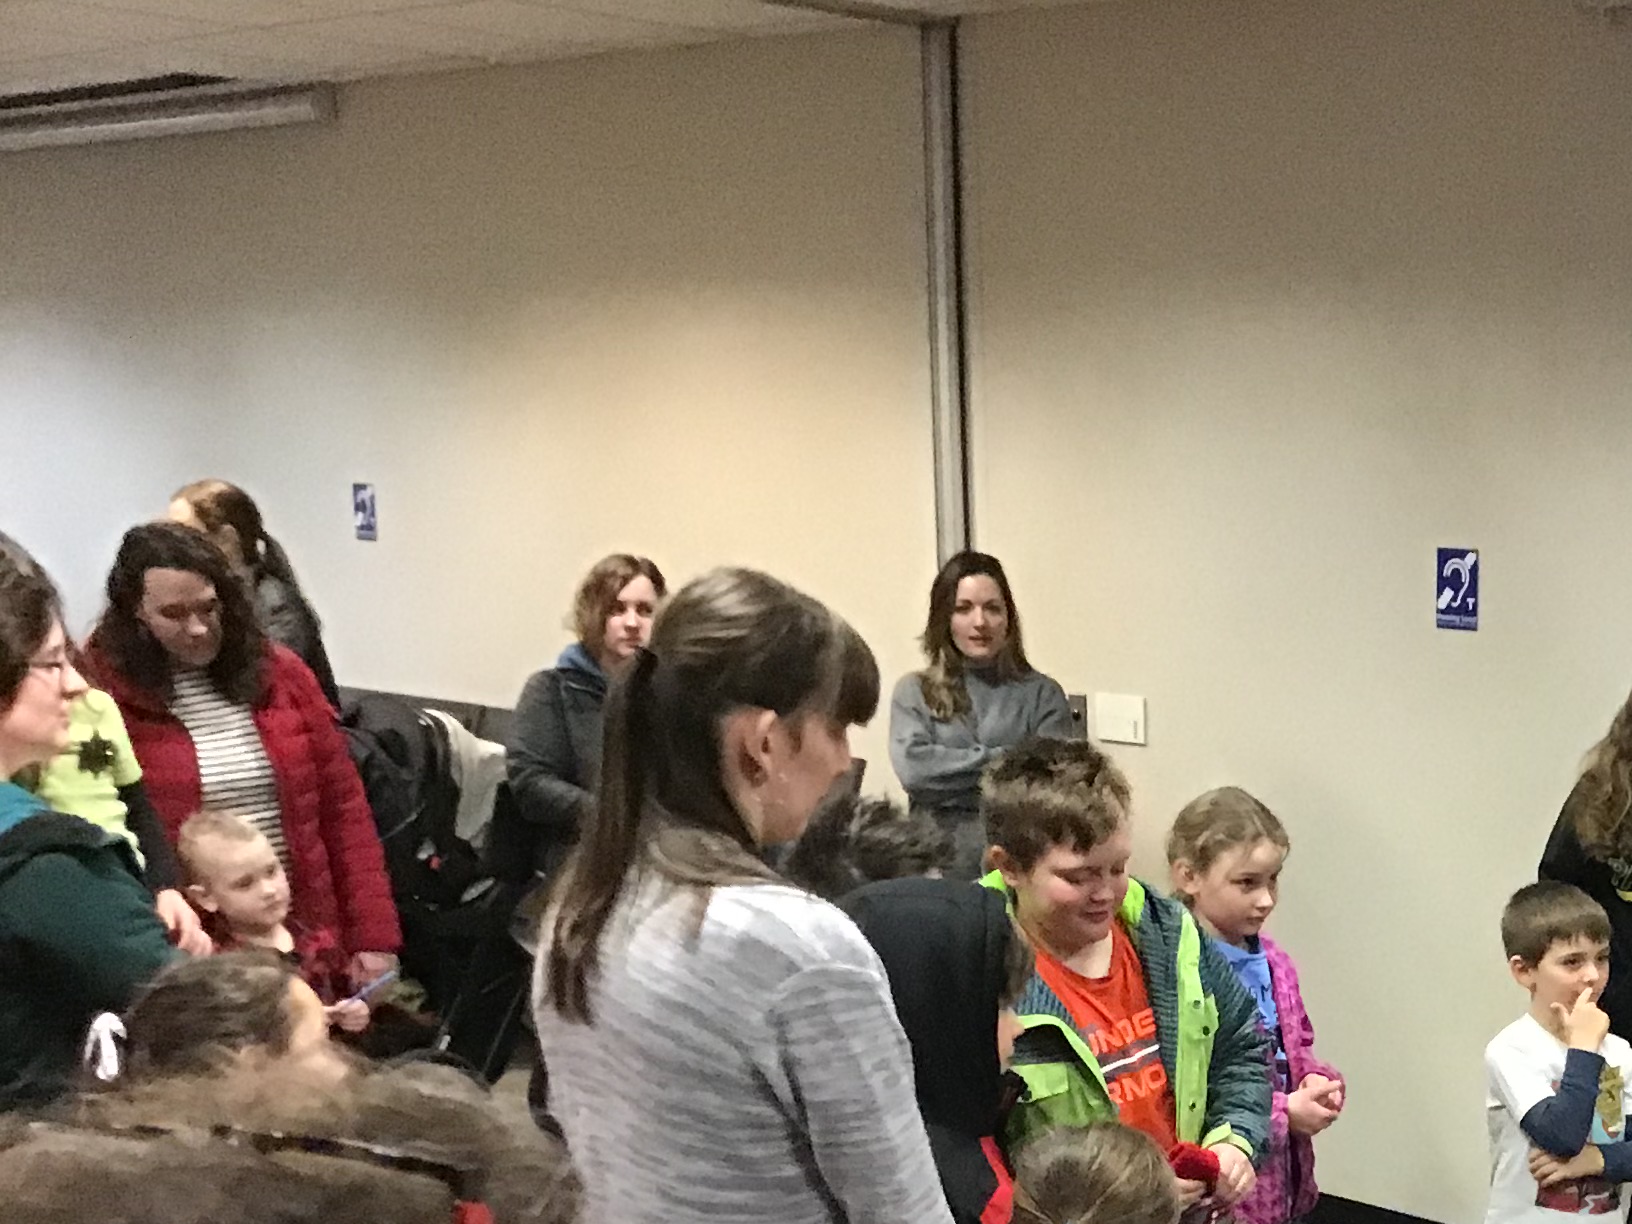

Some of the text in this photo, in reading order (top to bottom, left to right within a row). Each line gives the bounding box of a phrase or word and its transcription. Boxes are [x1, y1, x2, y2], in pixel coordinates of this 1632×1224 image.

[1466, 598, 1476, 610] T
[1088, 1008, 1157, 1056] NDE
[1107, 1063, 1167, 1104] RMO
